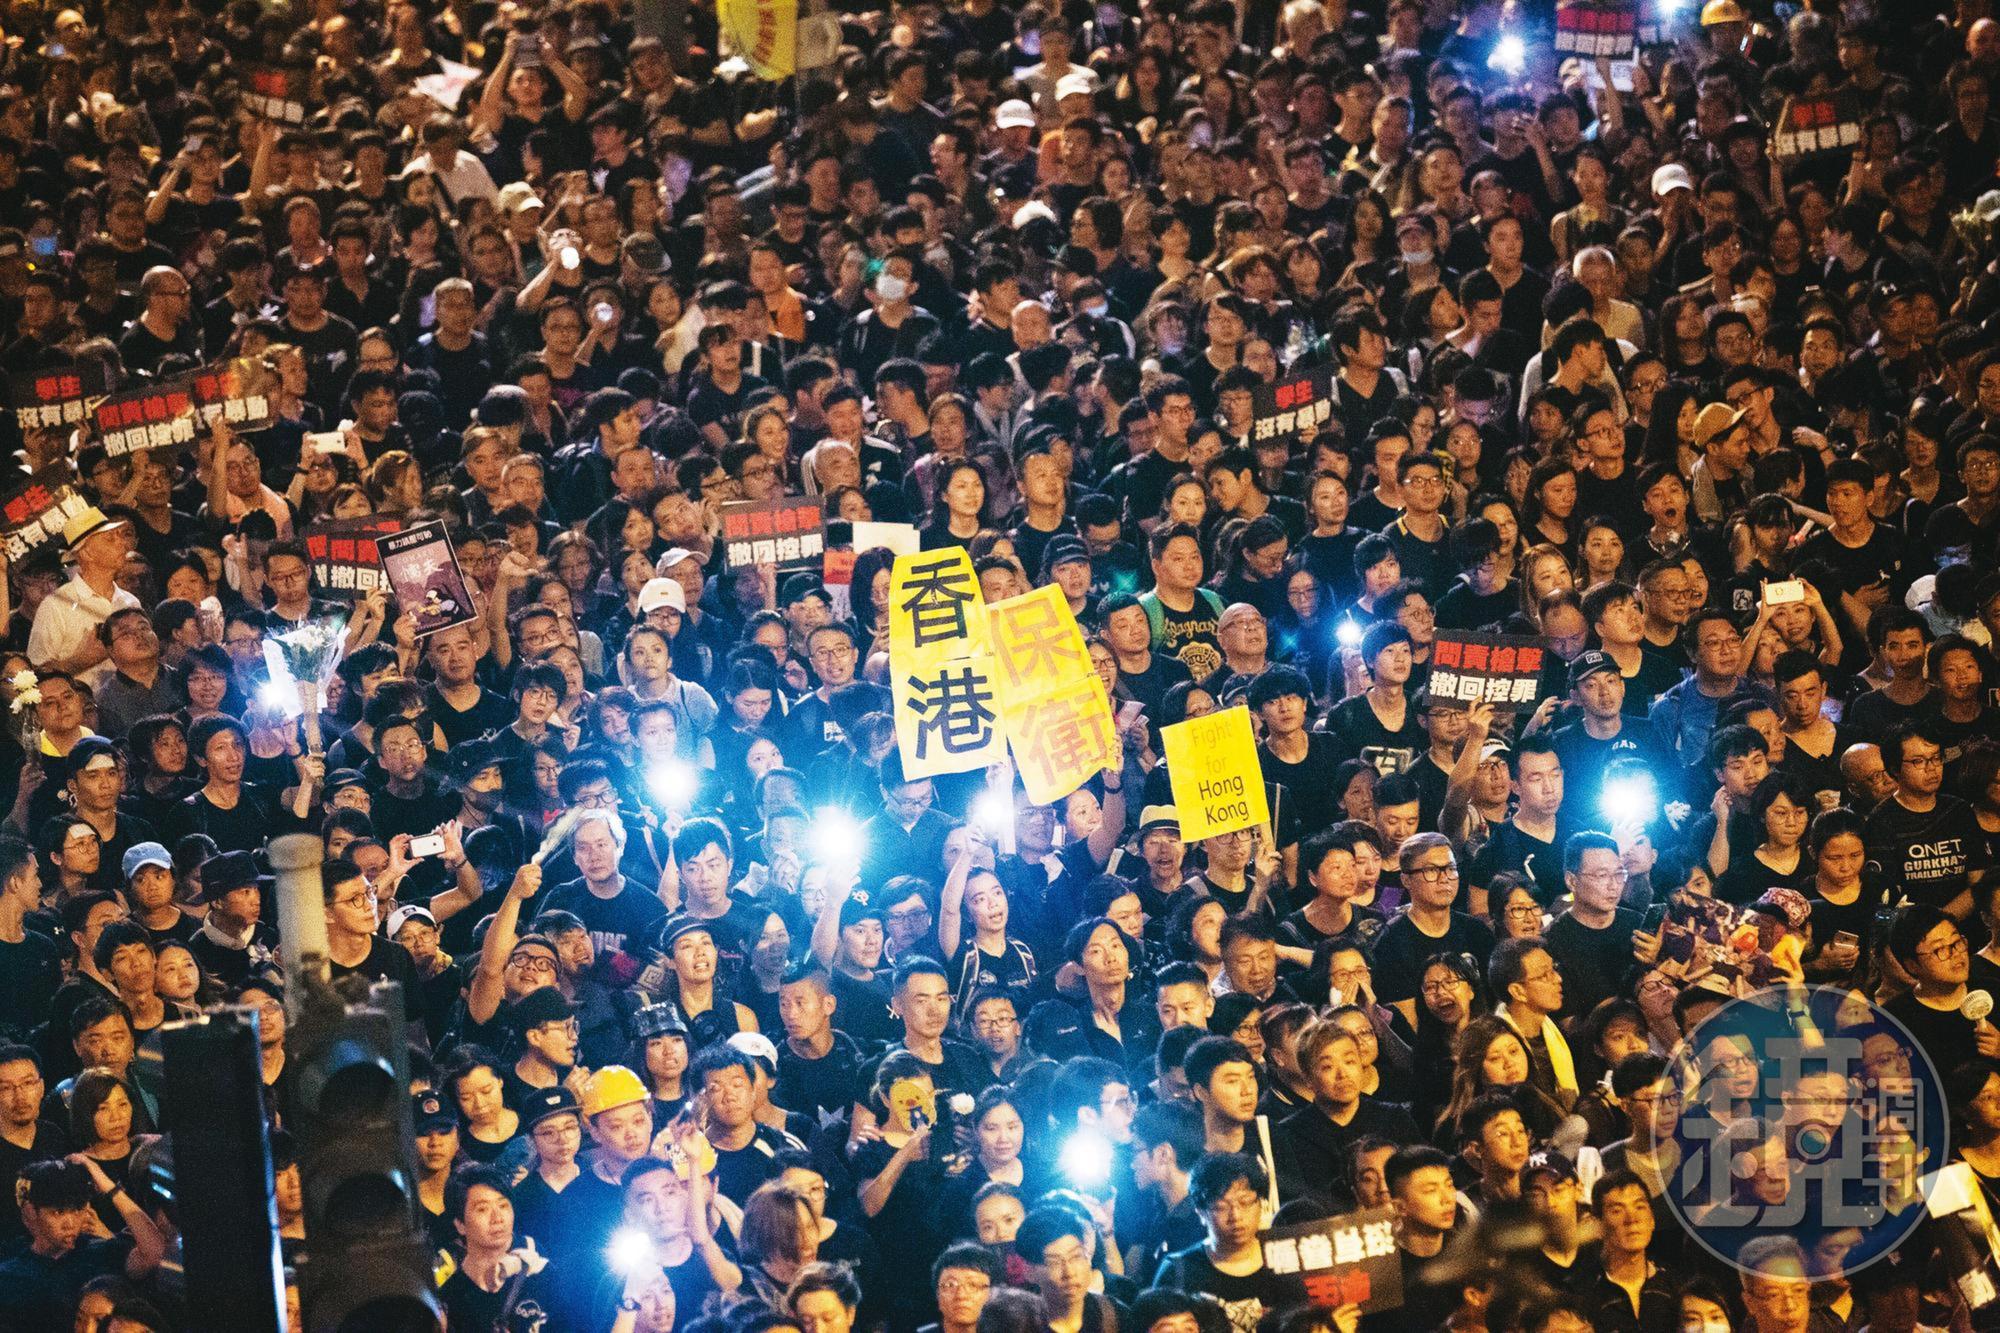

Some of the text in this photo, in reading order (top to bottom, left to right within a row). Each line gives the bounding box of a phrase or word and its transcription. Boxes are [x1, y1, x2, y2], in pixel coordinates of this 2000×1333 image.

[103, 416, 195, 458] 撤回控罪
[728, 533, 824, 567] 撤回控罪
[901, 557, 997, 760] 香港
[1433, 640, 1544, 673] 問責槍擊
[990, 596, 1108, 787] 保衛
[1429, 670, 1538, 703] 撤回控罪
[1191, 720, 1234, 749] Fight
[1612, 740, 1638, 751] GAP
[1205, 755, 1227, 776] for
[1198, 775, 1245, 801] Hong
[1204, 801, 1250, 826] Kong
[1908, 838, 1962, 859] QNET
